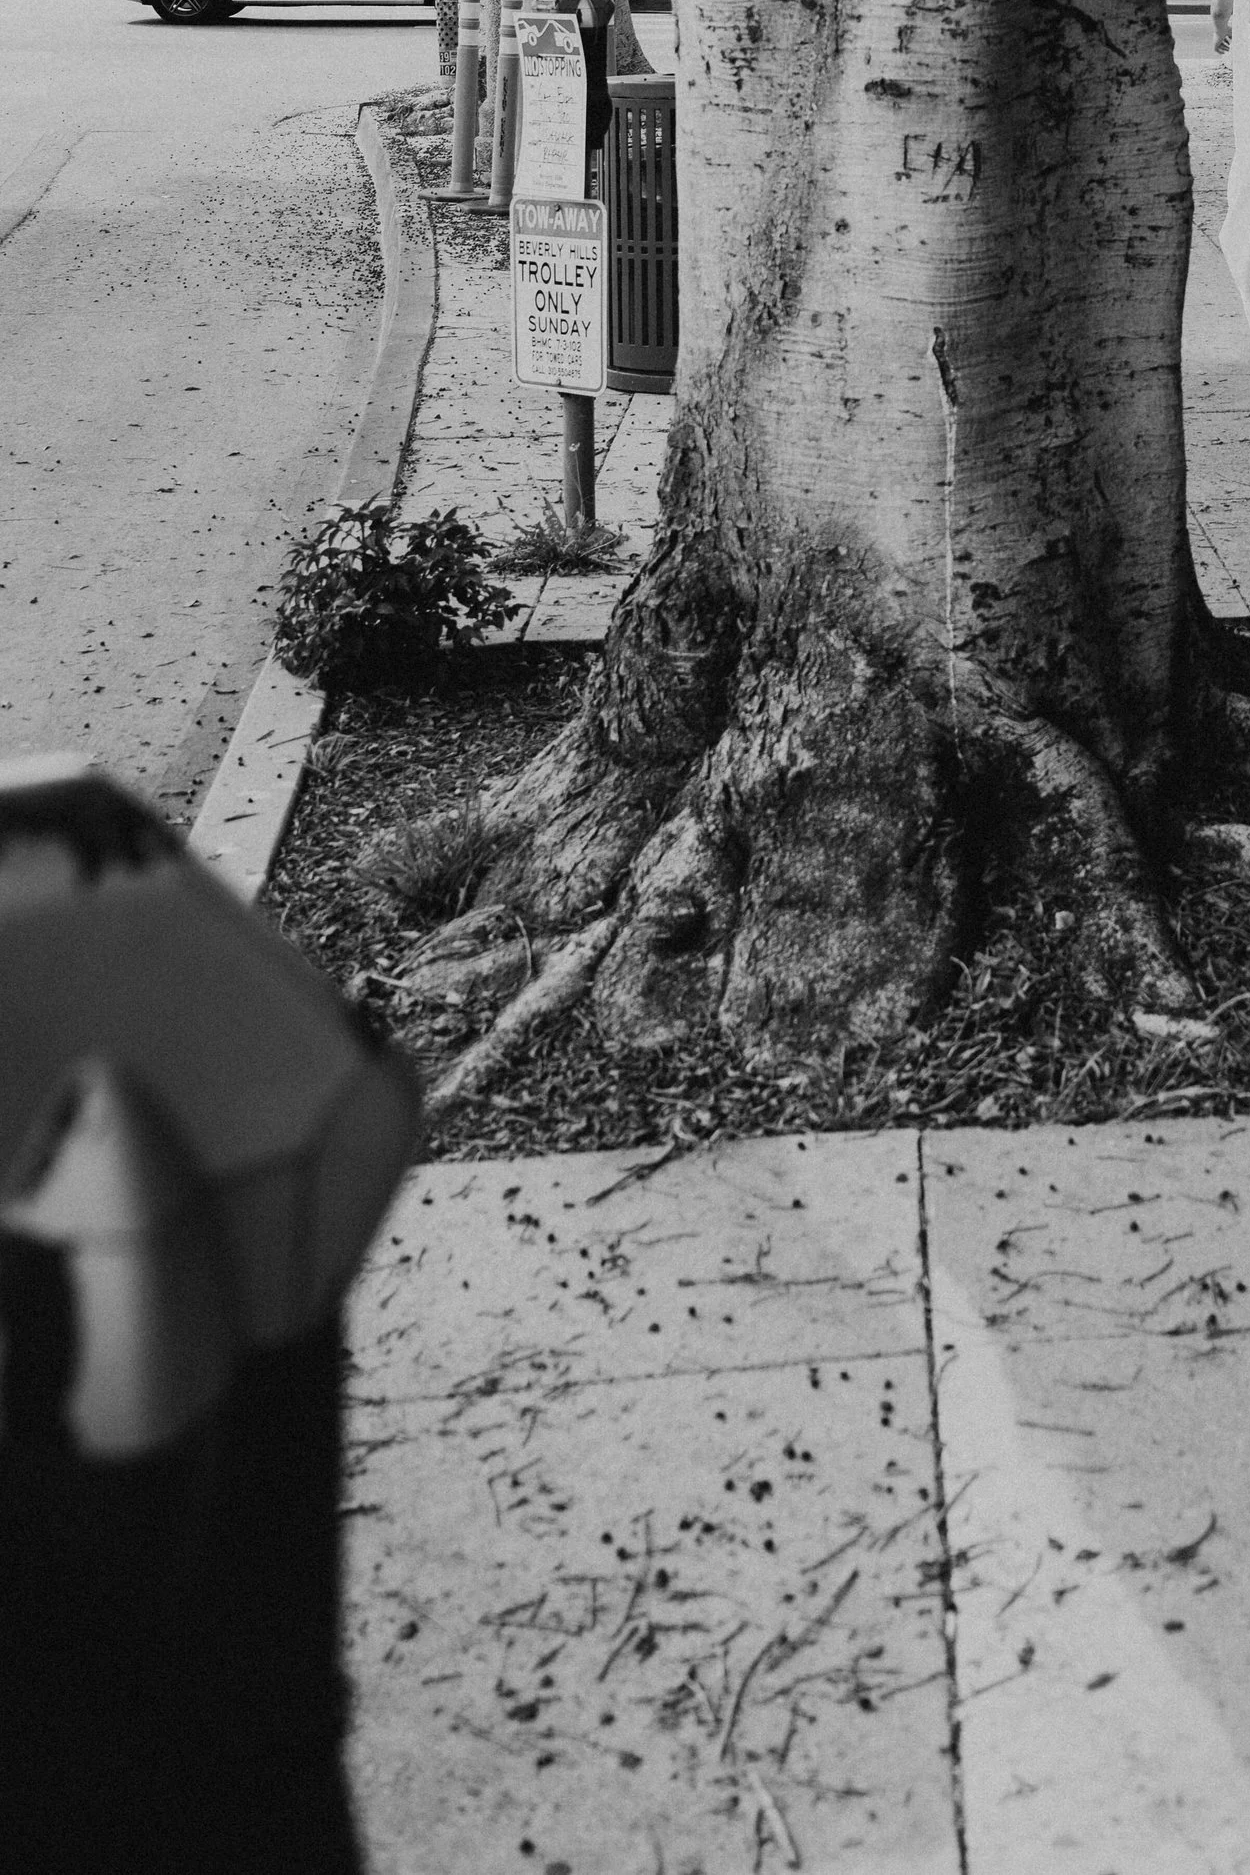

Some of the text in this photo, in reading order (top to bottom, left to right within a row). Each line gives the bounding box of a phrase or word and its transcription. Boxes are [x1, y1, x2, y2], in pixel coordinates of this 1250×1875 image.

[524, 55, 582, 78] NO STOPPING
[515, 203, 601, 233] TOW-AWAY
[519, 240, 598, 261] BEVERLY HILLS
[518, 260, 597, 288] TROLLEY
[534, 290, 582, 316] ONLY
[528, 315, 591, 337] SUNDAY
